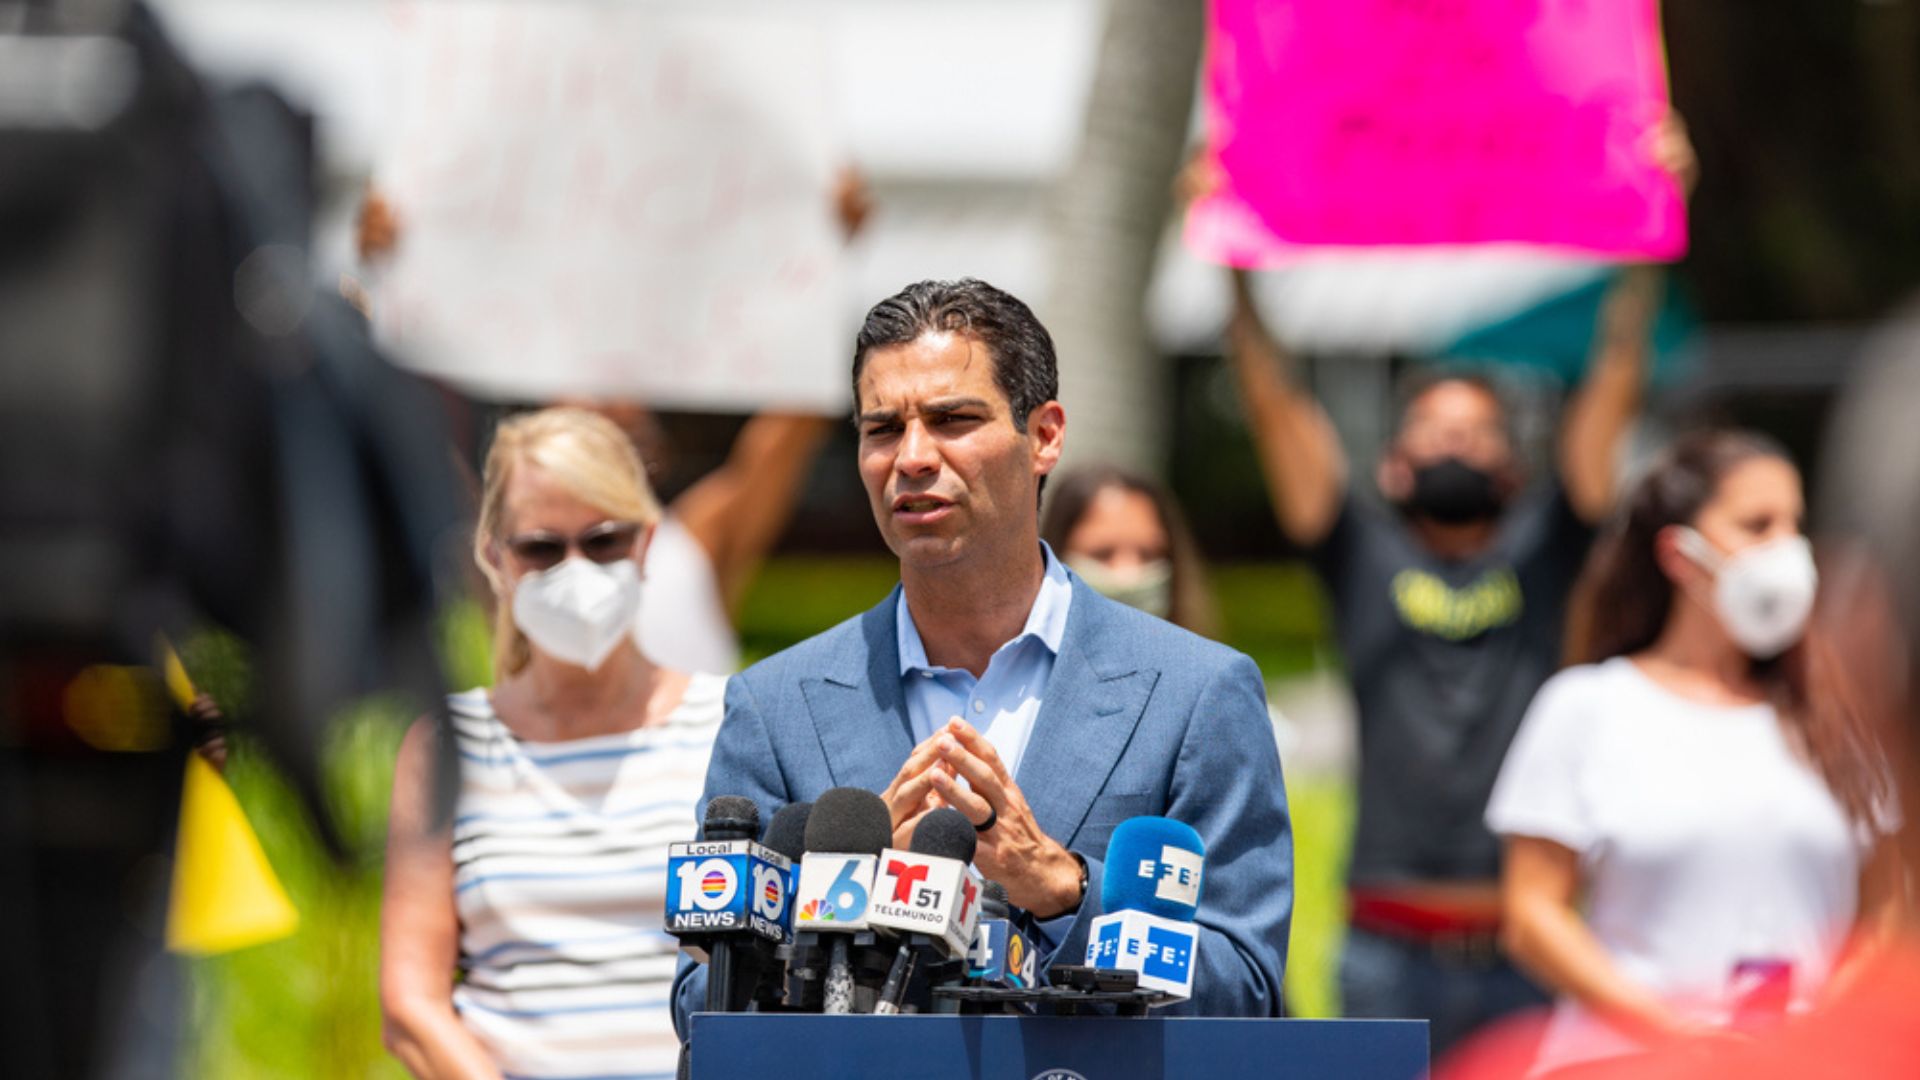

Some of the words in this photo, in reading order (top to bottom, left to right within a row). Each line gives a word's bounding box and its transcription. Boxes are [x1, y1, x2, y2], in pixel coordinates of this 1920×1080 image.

[686, 842, 732, 855] Local
[676, 858, 738, 911] 10
[752, 862, 784, 921] 10
[826, 859, 868, 922] 6
[915, 888, 942, 909] 51
[675, 911, 735, 928] NEWS
[750, 914, 782, 940] NEWS
[874, 903, 944, 924] TELEMUNDO
[968, 923, 993, 967] 4
[1021, 947, 1036, 989] 4
